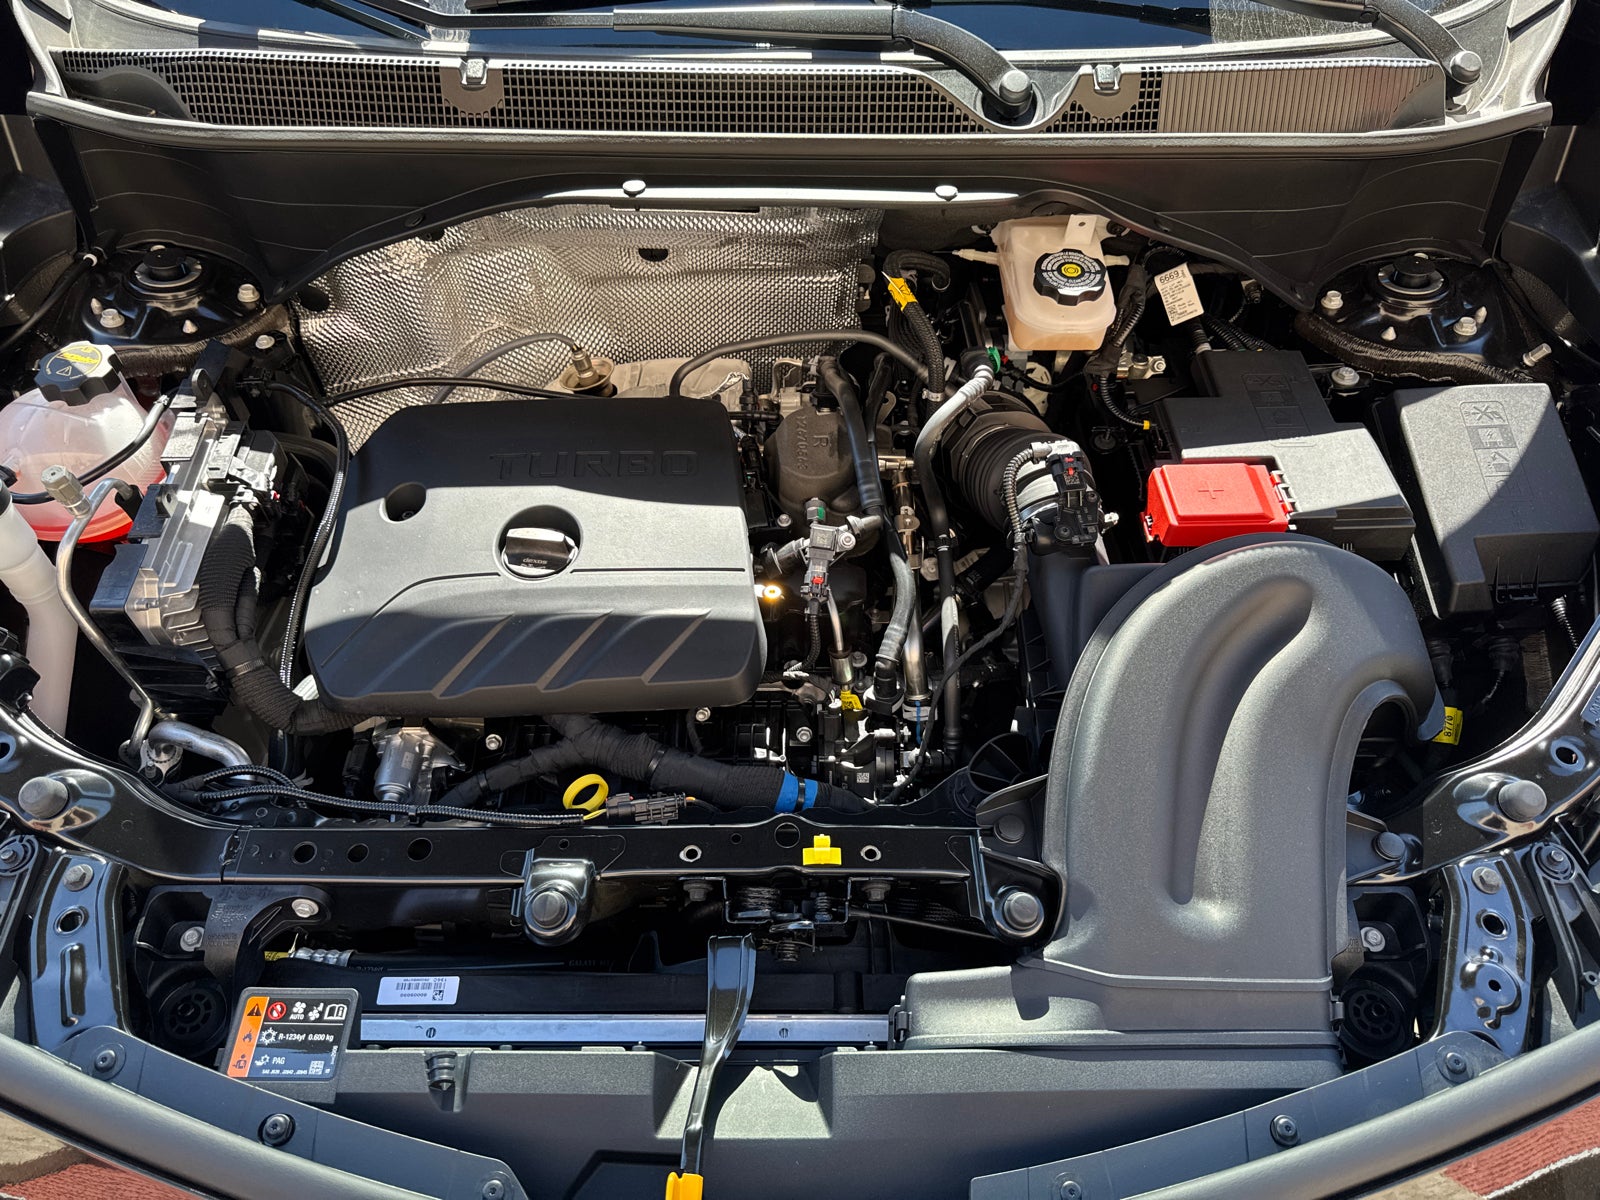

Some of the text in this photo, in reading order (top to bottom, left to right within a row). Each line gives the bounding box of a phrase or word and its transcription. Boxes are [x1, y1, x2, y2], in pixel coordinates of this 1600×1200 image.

[1159, 270, 1180, 284] 6669
[489, 450, 698, 480] TURBO
[522, 557, 548, 565] dexos
[1443, 715, 1453, 737] 8770
[278, 1033, 306, 1042] R-1234yf
[326, 1034, 335, 1042] kg
[272, 1056, 286, 1065] PAG
